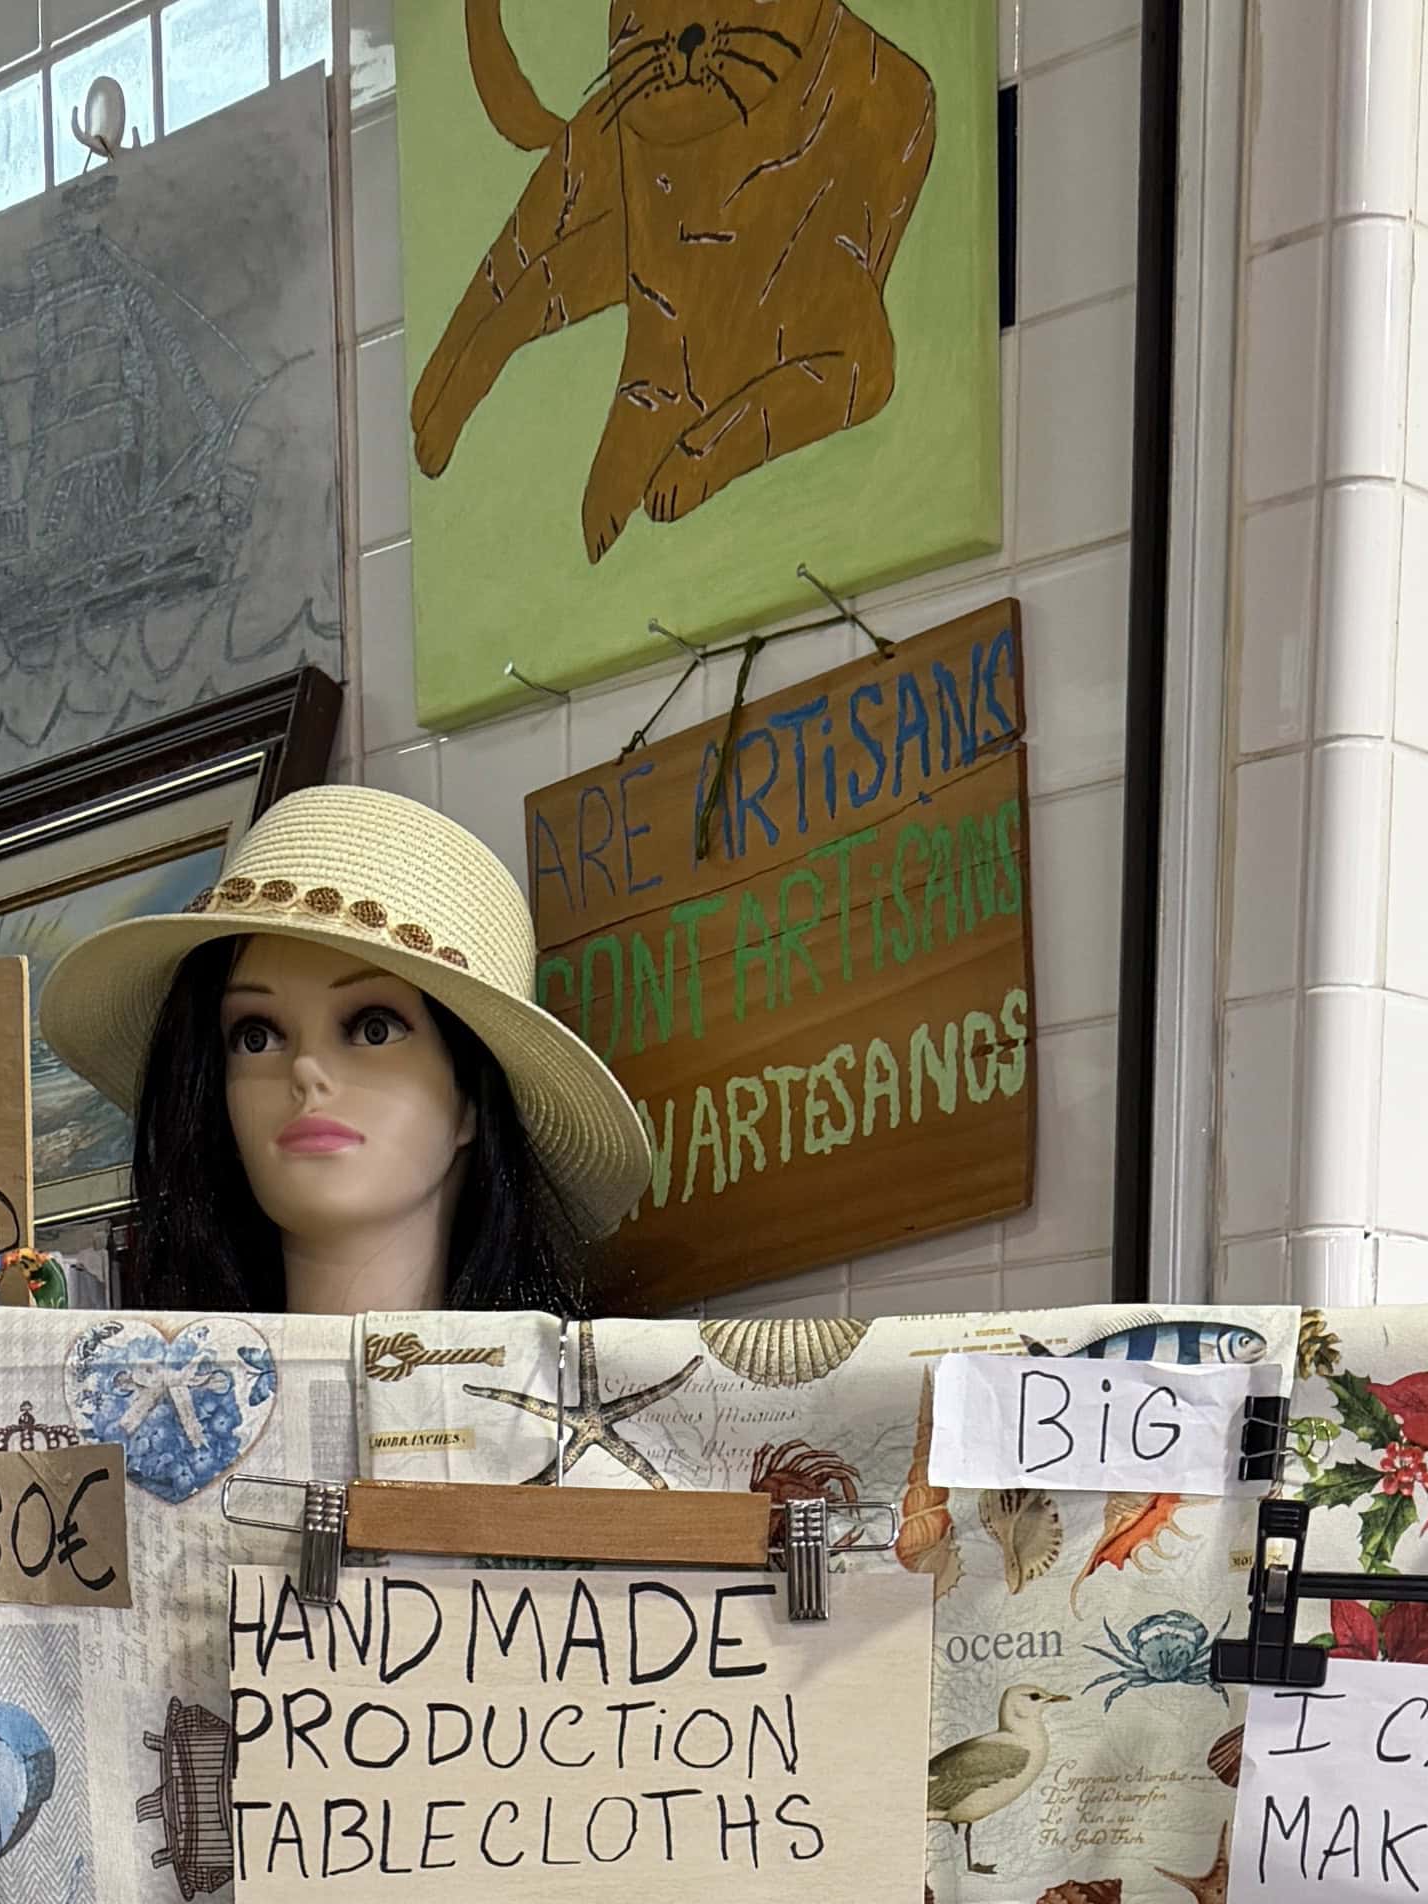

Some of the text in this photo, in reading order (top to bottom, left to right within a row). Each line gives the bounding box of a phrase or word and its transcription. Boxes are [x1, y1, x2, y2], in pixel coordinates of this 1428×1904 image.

[531, 759, 665, 912] ARE
[946, 1627, 1063, 1665] ocean
[1266, 1690, 1346, 1758] I
[232, 1789, 826, 1881] TABLECLOTHS
